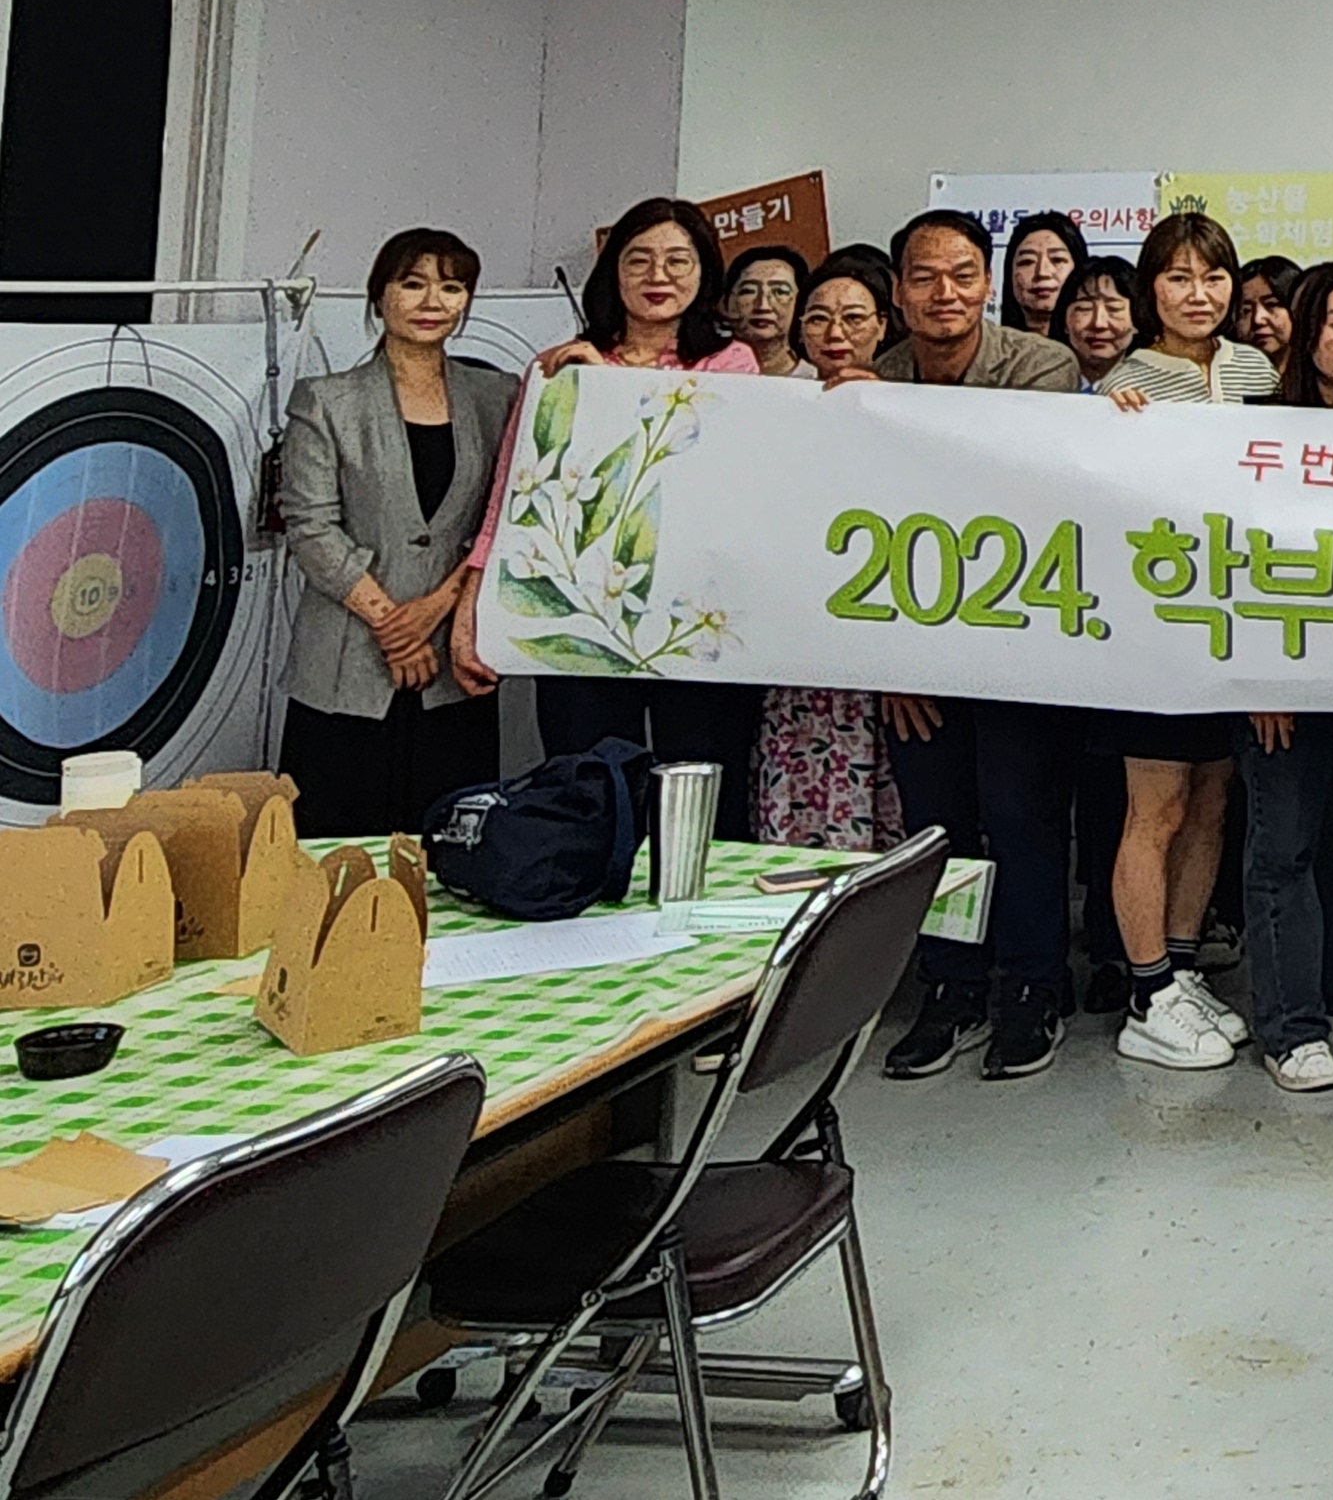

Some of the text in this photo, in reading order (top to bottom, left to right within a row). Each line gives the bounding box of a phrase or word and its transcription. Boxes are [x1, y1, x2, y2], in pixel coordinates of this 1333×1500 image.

[713, 193, 792, 241] 만들기
[1237, 439, 1285, 482] 두
[80, 586, 101, 606] 10
[204, 569, 217, 586] 4
[228, 566, 239, 585] 3
[244, 564, 254, 582] 2
[825, 508, 1112, 641] 2024.
